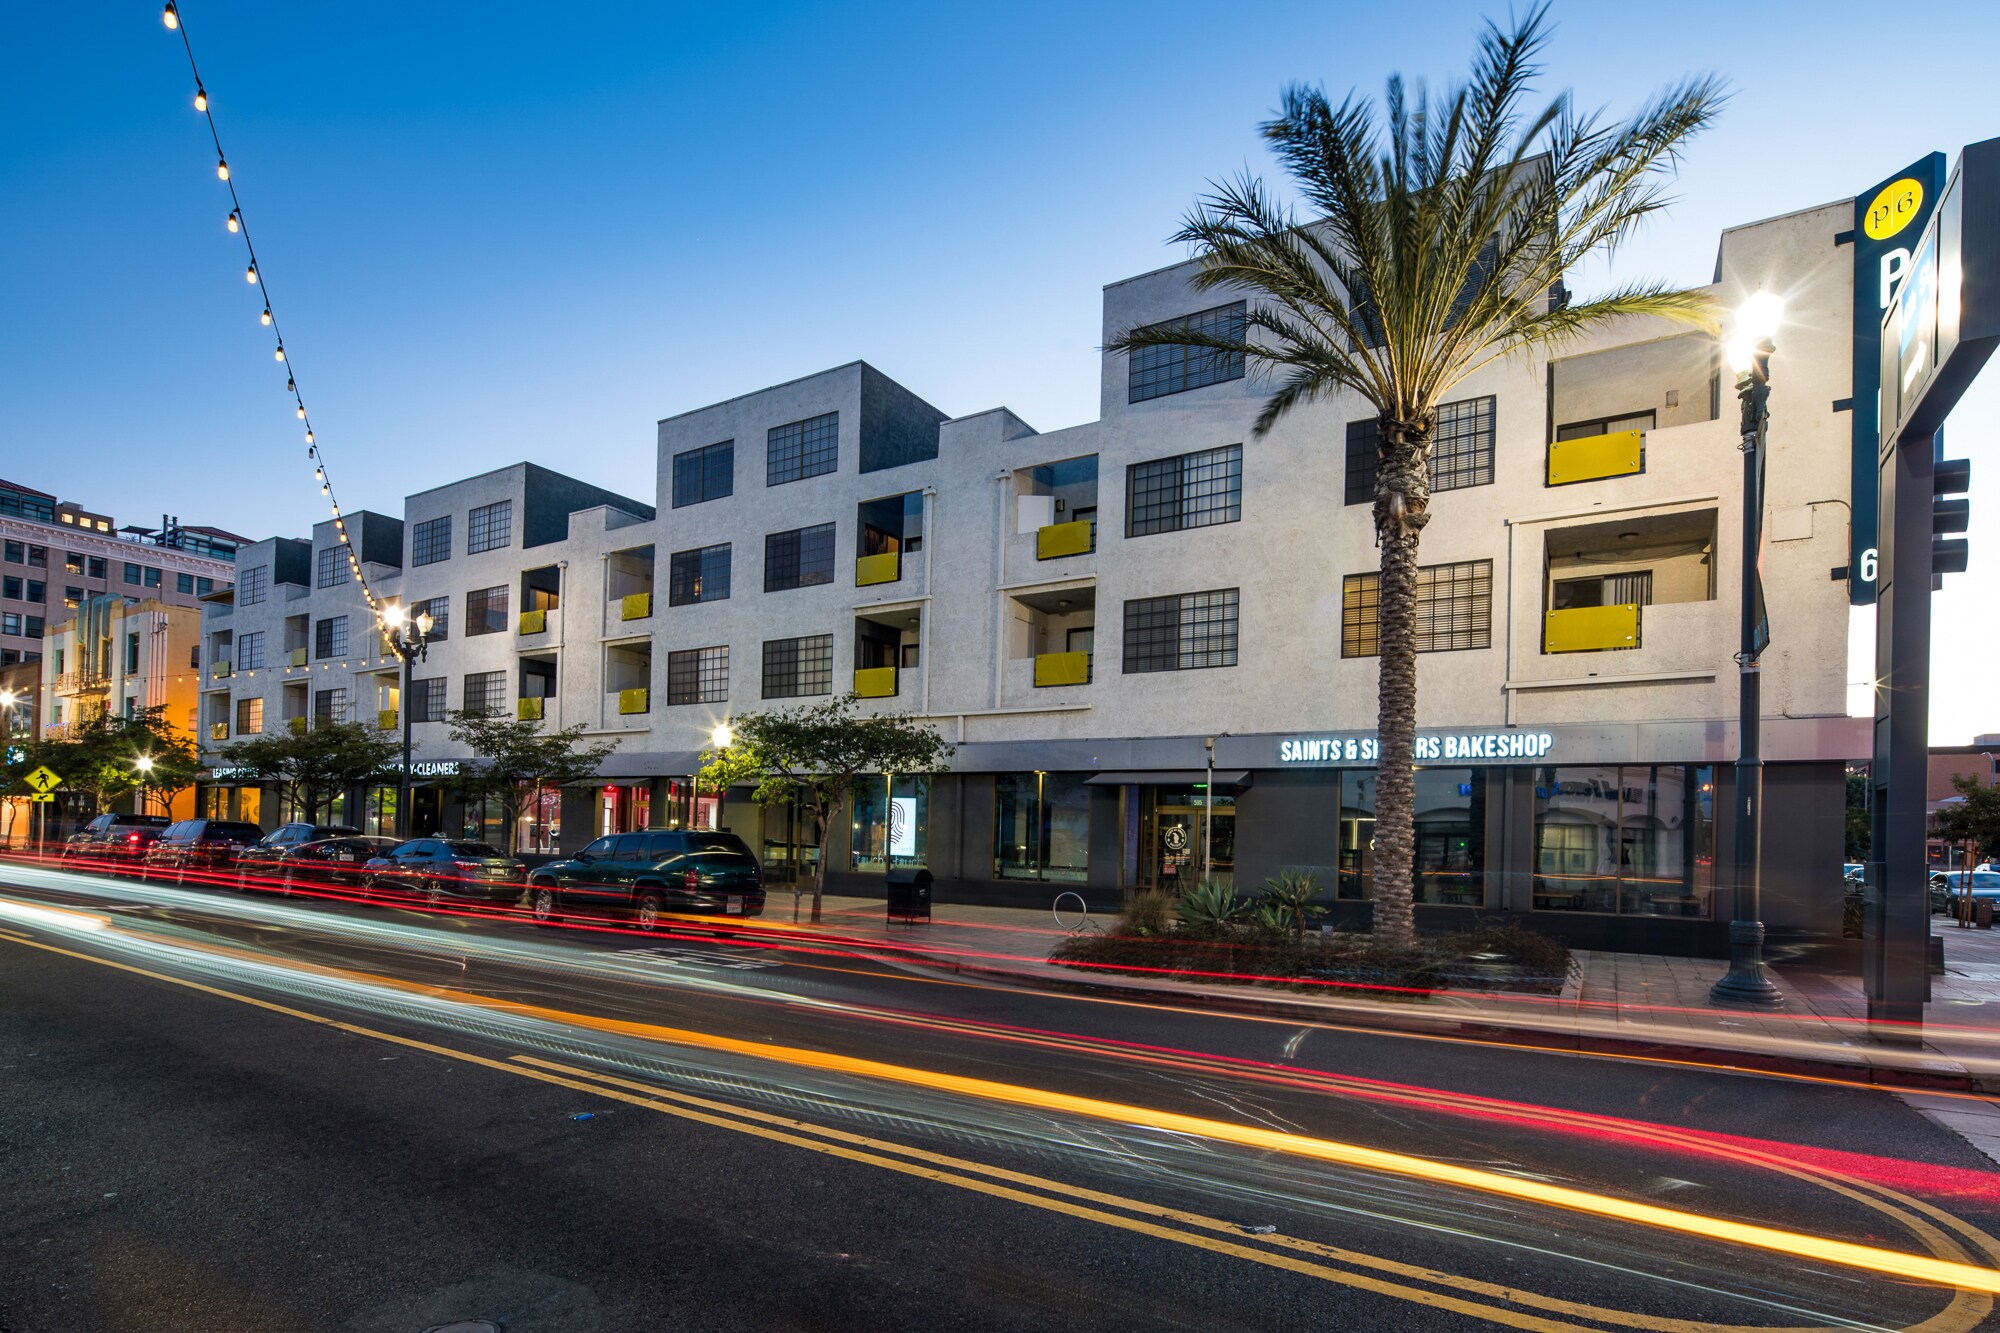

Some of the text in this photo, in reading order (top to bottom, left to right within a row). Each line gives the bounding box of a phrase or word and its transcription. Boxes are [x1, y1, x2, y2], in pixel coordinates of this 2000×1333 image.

[1281, 733, 1552, 762] SAINTS & SIRS BAKESHOP
